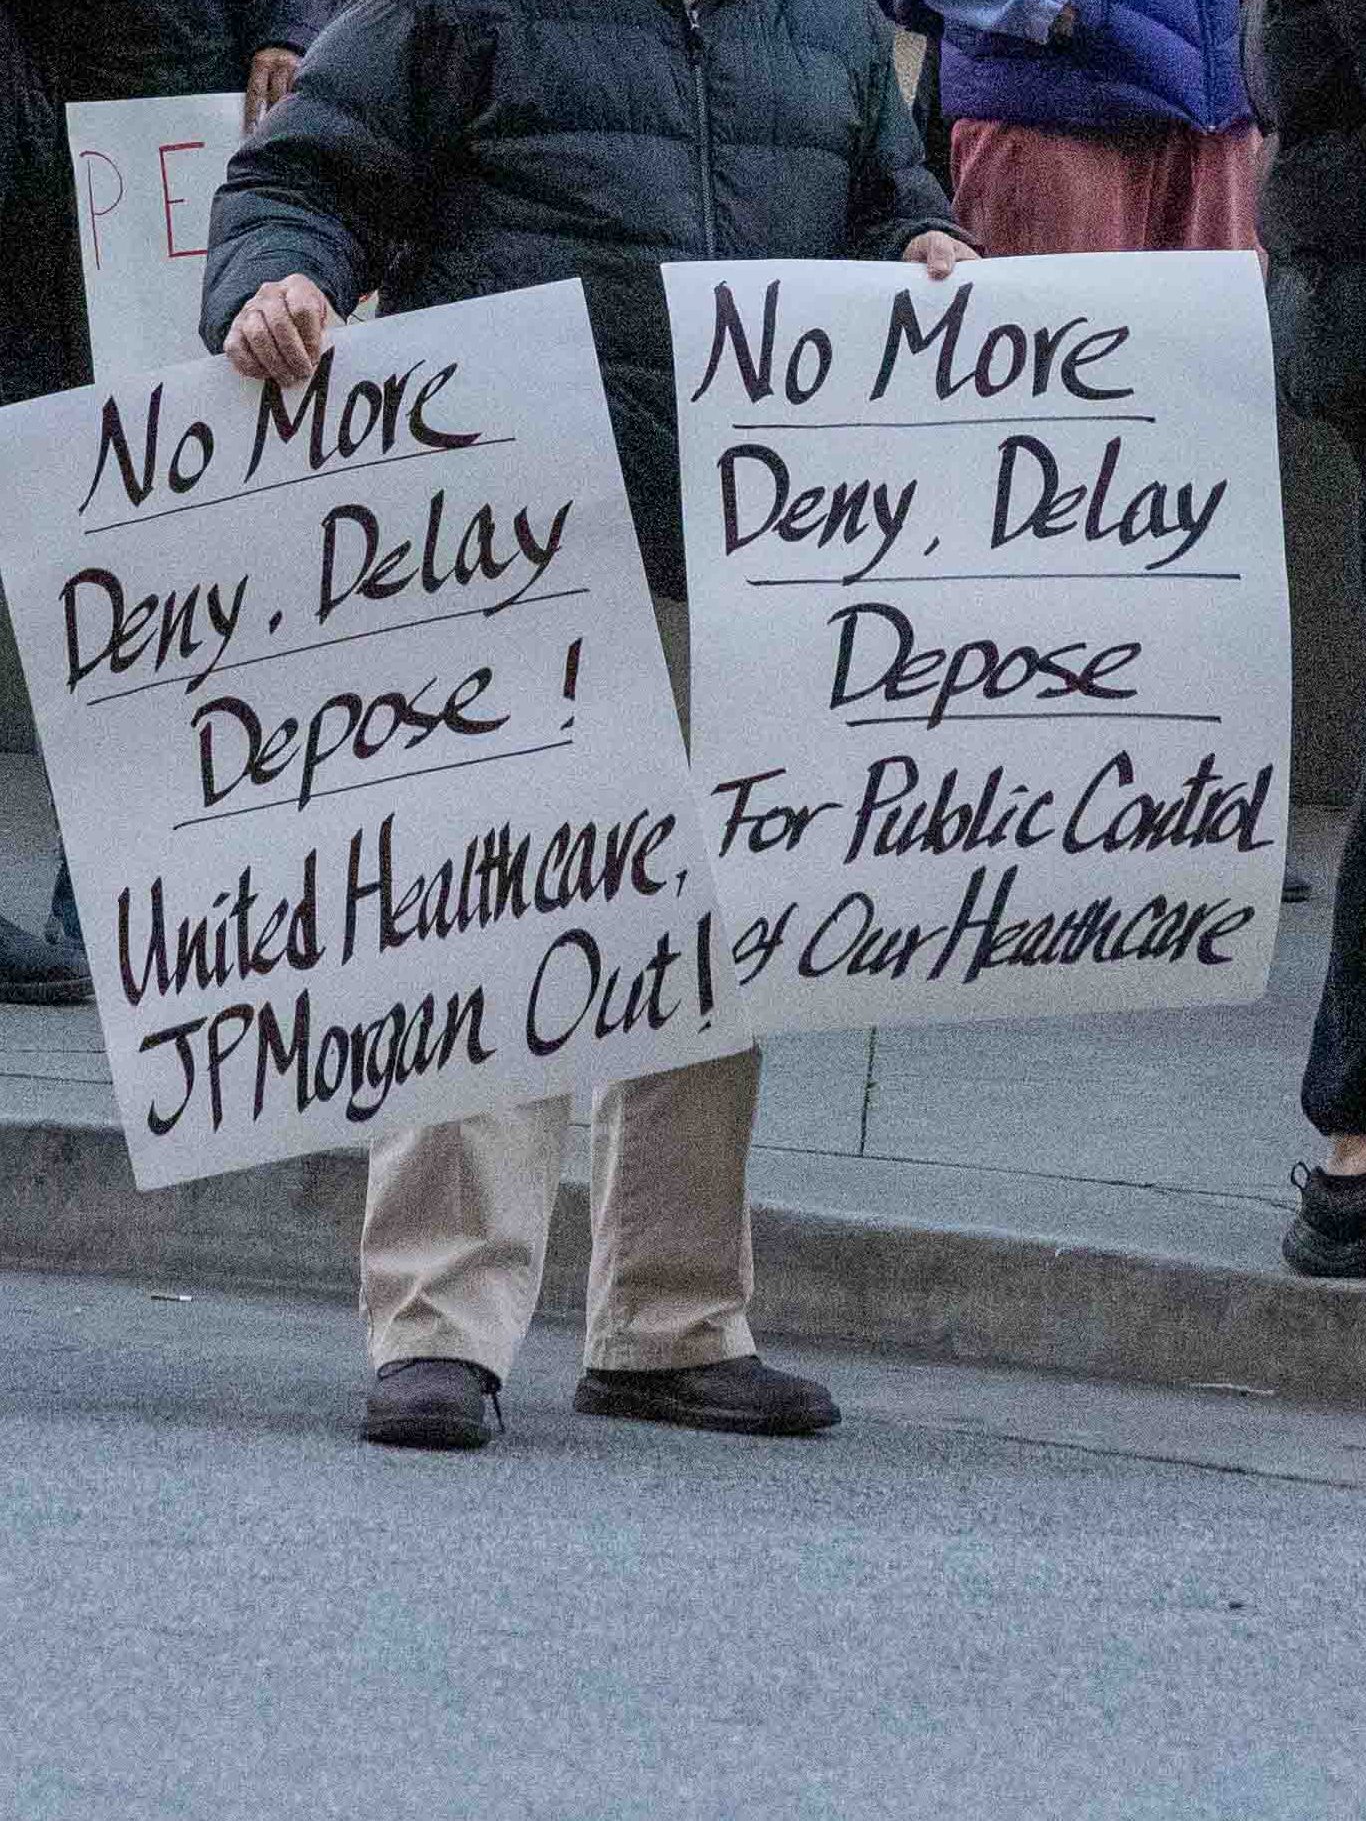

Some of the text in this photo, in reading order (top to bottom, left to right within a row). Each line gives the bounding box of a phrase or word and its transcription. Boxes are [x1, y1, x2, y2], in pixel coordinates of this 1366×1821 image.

[79, 140, 208, 271] PE
[691, 279, 1135, 406] No More
[79, 347, 482, 515] No More
[318, 489, 575, 625] Delay
[990, 434, 1228, 571] Delay
[828, 602, 1143, 730] Depose
[190, 666, 512, 810] Depose
[710, 748, 1274, 863] For Public Control
[118, 848, 326, 1007] United
[526, 911, 715, 1058] Out!
[731, 864, 1256, 988] of Our Healthcare
